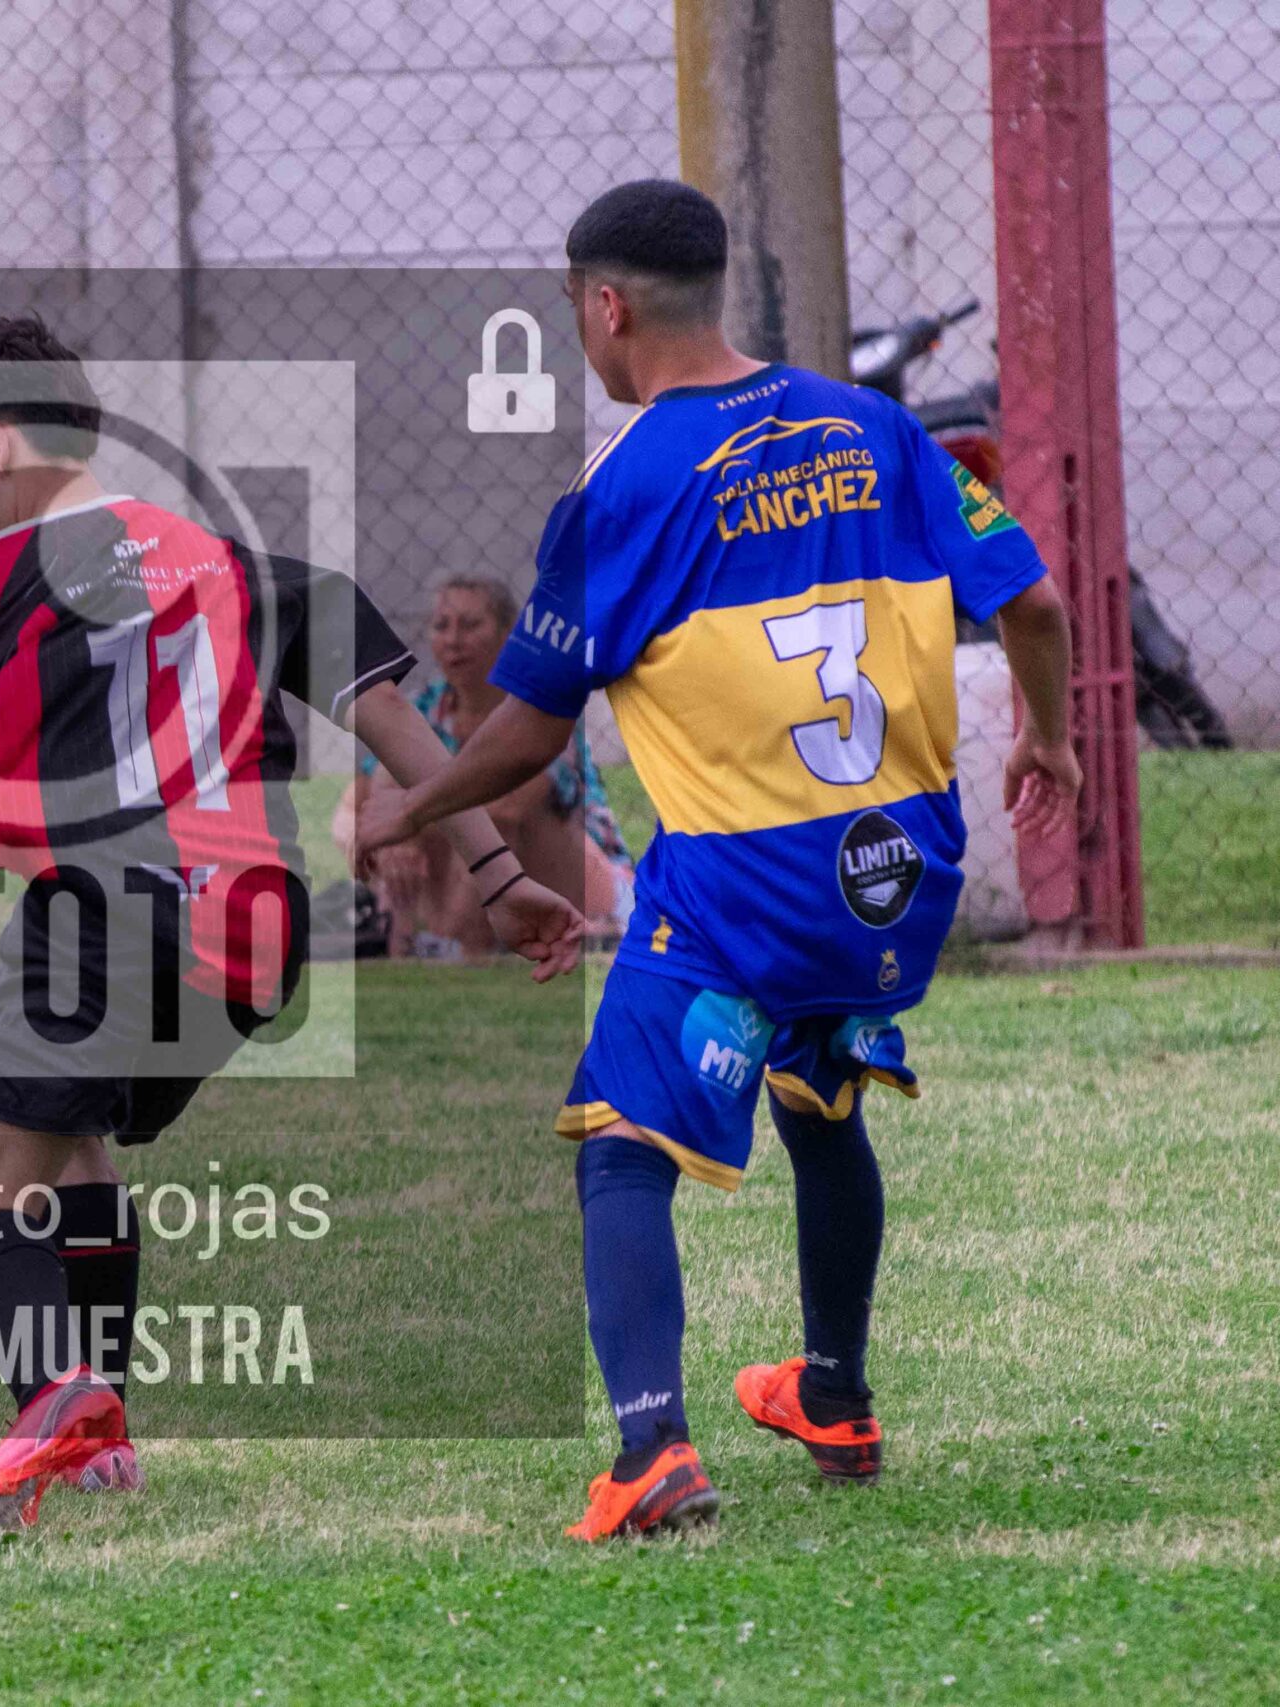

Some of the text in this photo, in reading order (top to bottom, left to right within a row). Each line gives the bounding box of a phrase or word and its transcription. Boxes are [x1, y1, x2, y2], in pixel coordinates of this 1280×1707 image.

[716, 469, 881, 541] LANCHEZ
[86, 612, 231, 812] 11
[761, 598, 888, 786] 3
[845, 837, 917, 876] LIMITE
[699, 1038, 752, 1090] MTS
